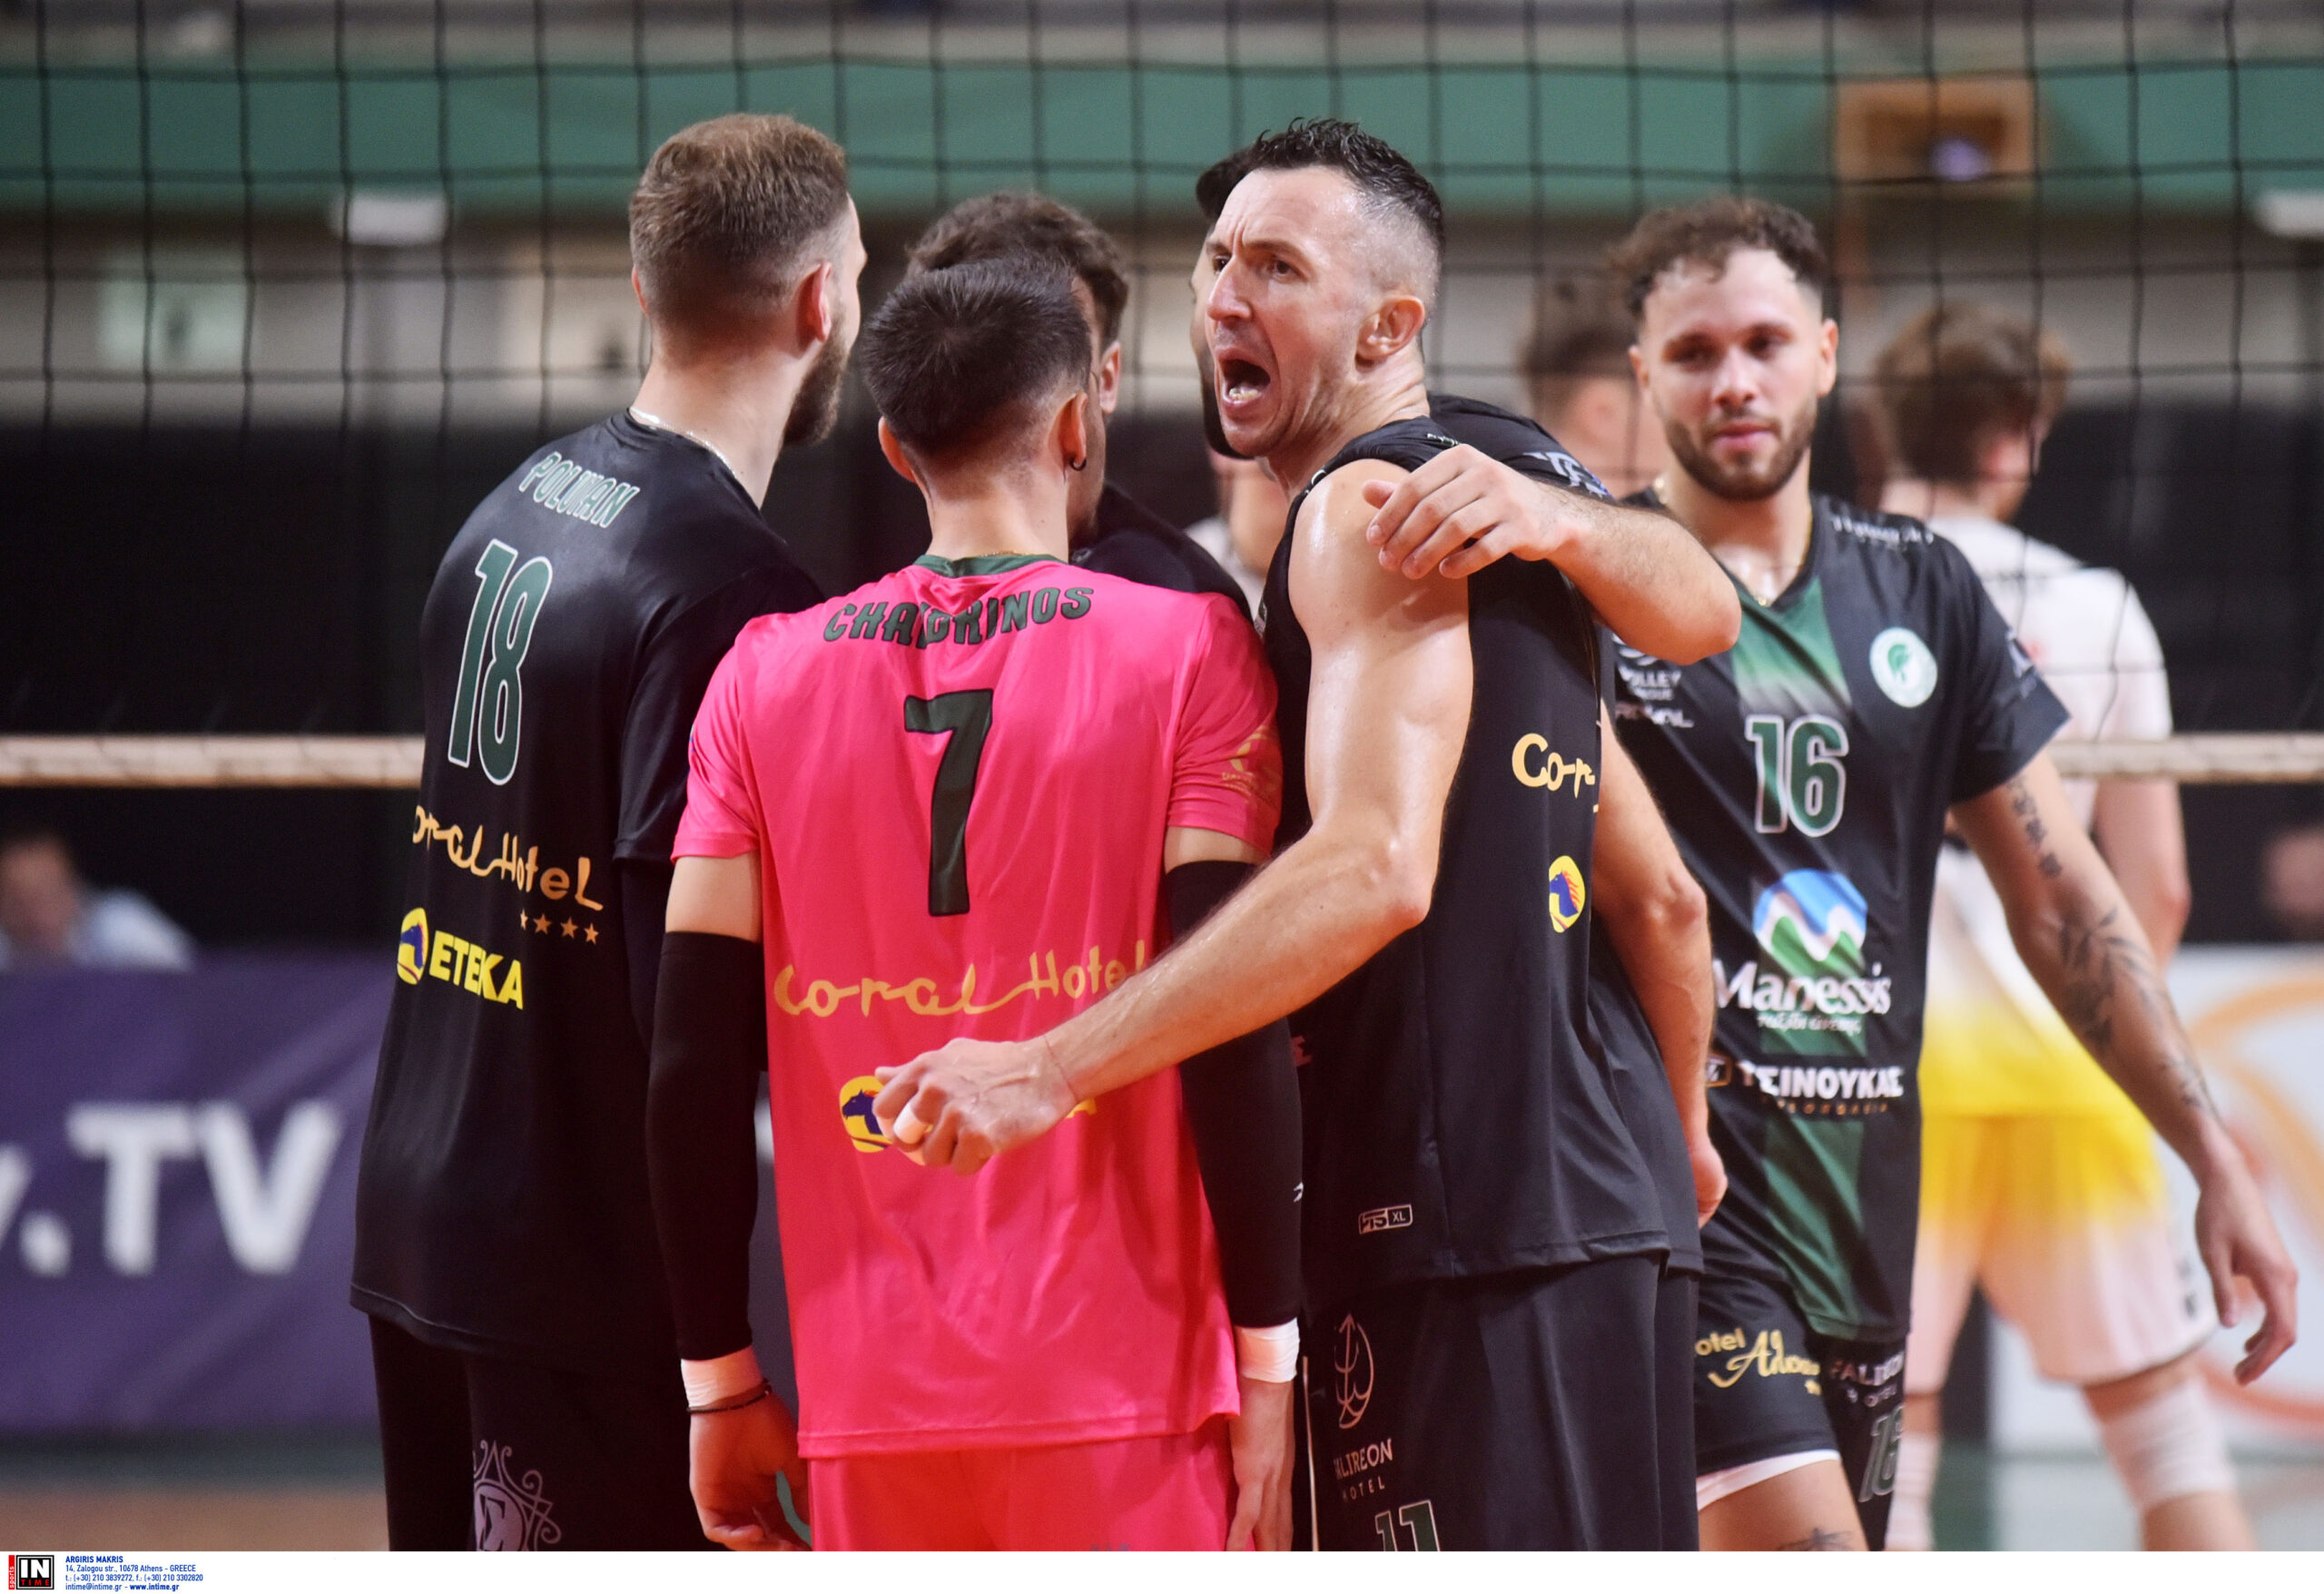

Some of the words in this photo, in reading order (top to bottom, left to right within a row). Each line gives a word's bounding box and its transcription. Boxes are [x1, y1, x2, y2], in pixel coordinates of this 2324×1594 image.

[448, 538, 553, 786] 18
[903, 688, 994, 918] 7
[1512, 733, 1596, 800] Cor
[1745, 714, 1850, 837] 16
[412, 804, 499, 878] oral
[428, 930, 524, 1010] ETEKA
[773, 963, 1028, 1018] Coral
[1392, 1210, 1406, 1223] XL
[1695, 1327, 1746, 1356] otel
